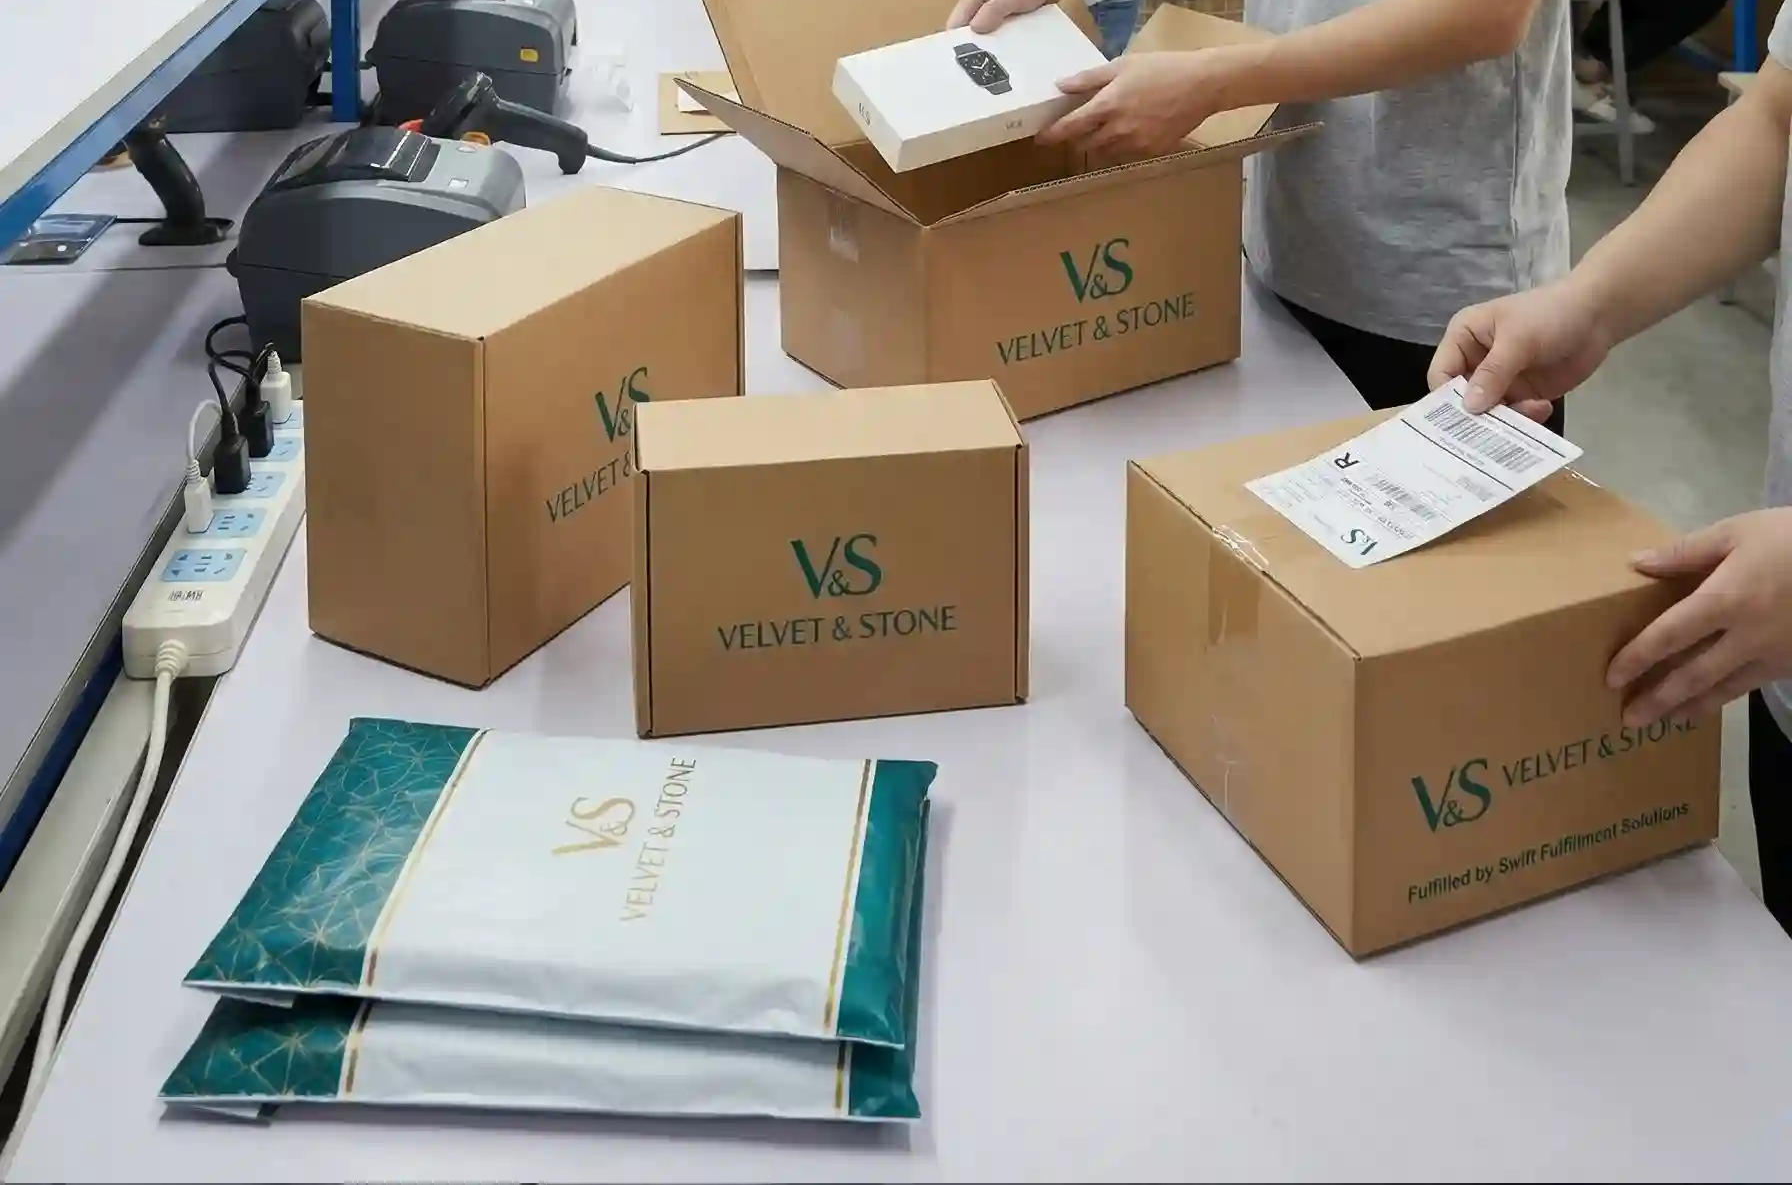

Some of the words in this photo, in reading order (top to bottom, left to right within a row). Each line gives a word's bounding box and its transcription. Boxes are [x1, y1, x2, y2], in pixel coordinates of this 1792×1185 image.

[1059, 237, 1134, 304] V&S
[996, 319, 1088, 366] VELVET
[1092, 315, 1111, 341] &
[1116, 292, 1196, 335] STONE
[545, 457, 620, 524] VELVET
[1333, 450, 1361, 471] R
[789, 533, 883, 600] V&S
[716, 617, 826, 651] VELVET
[831, 615, 853, 642] &
[858, 605, 958, 639] STONE
[653, 756, 697, 818] STONE
[1411, 758, 1492, 834] V&S
[1501, 738, 1594, 788] VELVET
[1596, 732, 1616, 760] &
[551, 795, 637, 857] V&S
[647, 823, 676, 839] &
[1407, 868, 1471, 905] Fulfilled
[1475, 861, 1495, 884] by
[1498, 845, 1537, 875] Swift
[1539, 823, 1619, 862] Fulfillment
[1621, 801, 1690, 836] Solutions
[619, 841, 670, 922] VELVET
